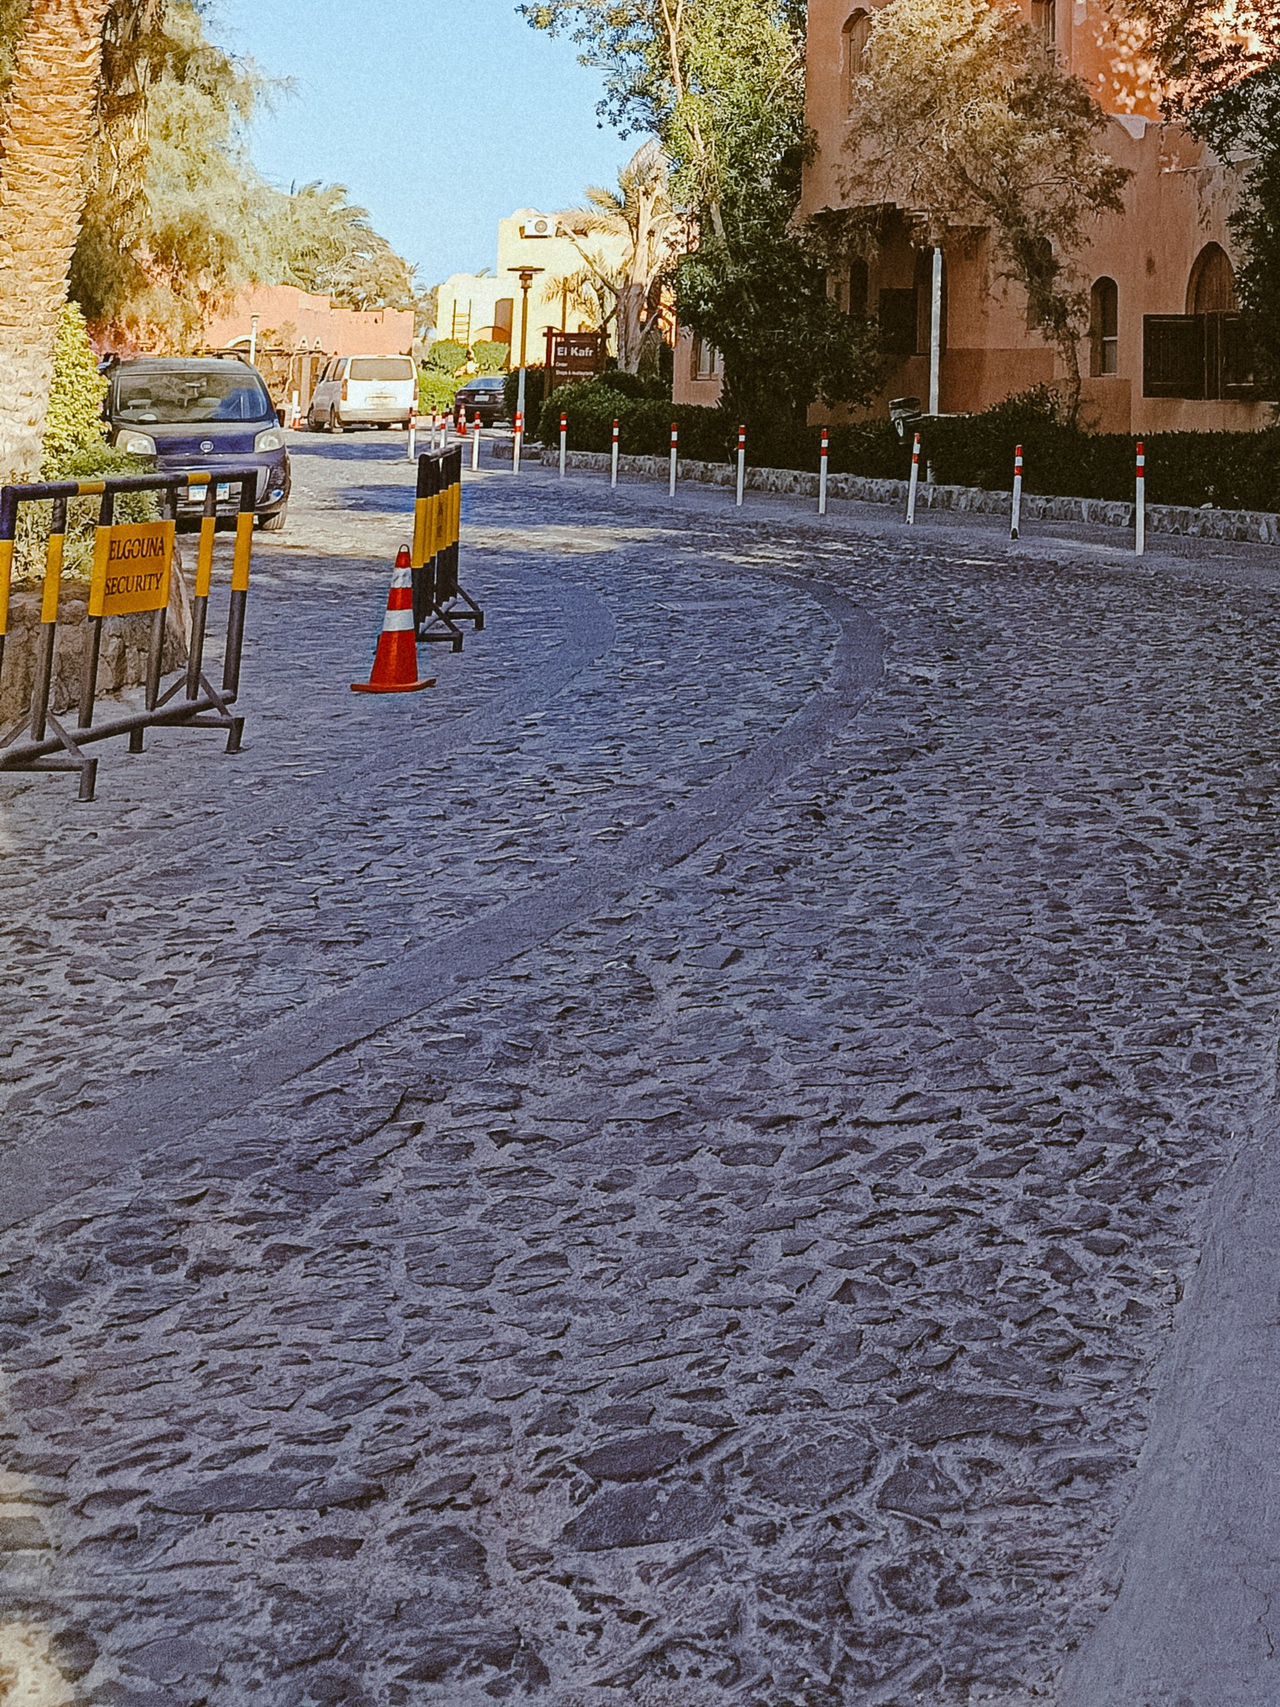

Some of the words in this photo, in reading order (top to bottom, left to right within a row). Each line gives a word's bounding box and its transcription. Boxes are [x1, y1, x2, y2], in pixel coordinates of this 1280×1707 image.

[557, 347, 568, 356] El
[571, 347, 594, 357] Kafr
[109, 537, 165, 560] ELGOUNA
[105, 572, 163, 595] SECURITY
